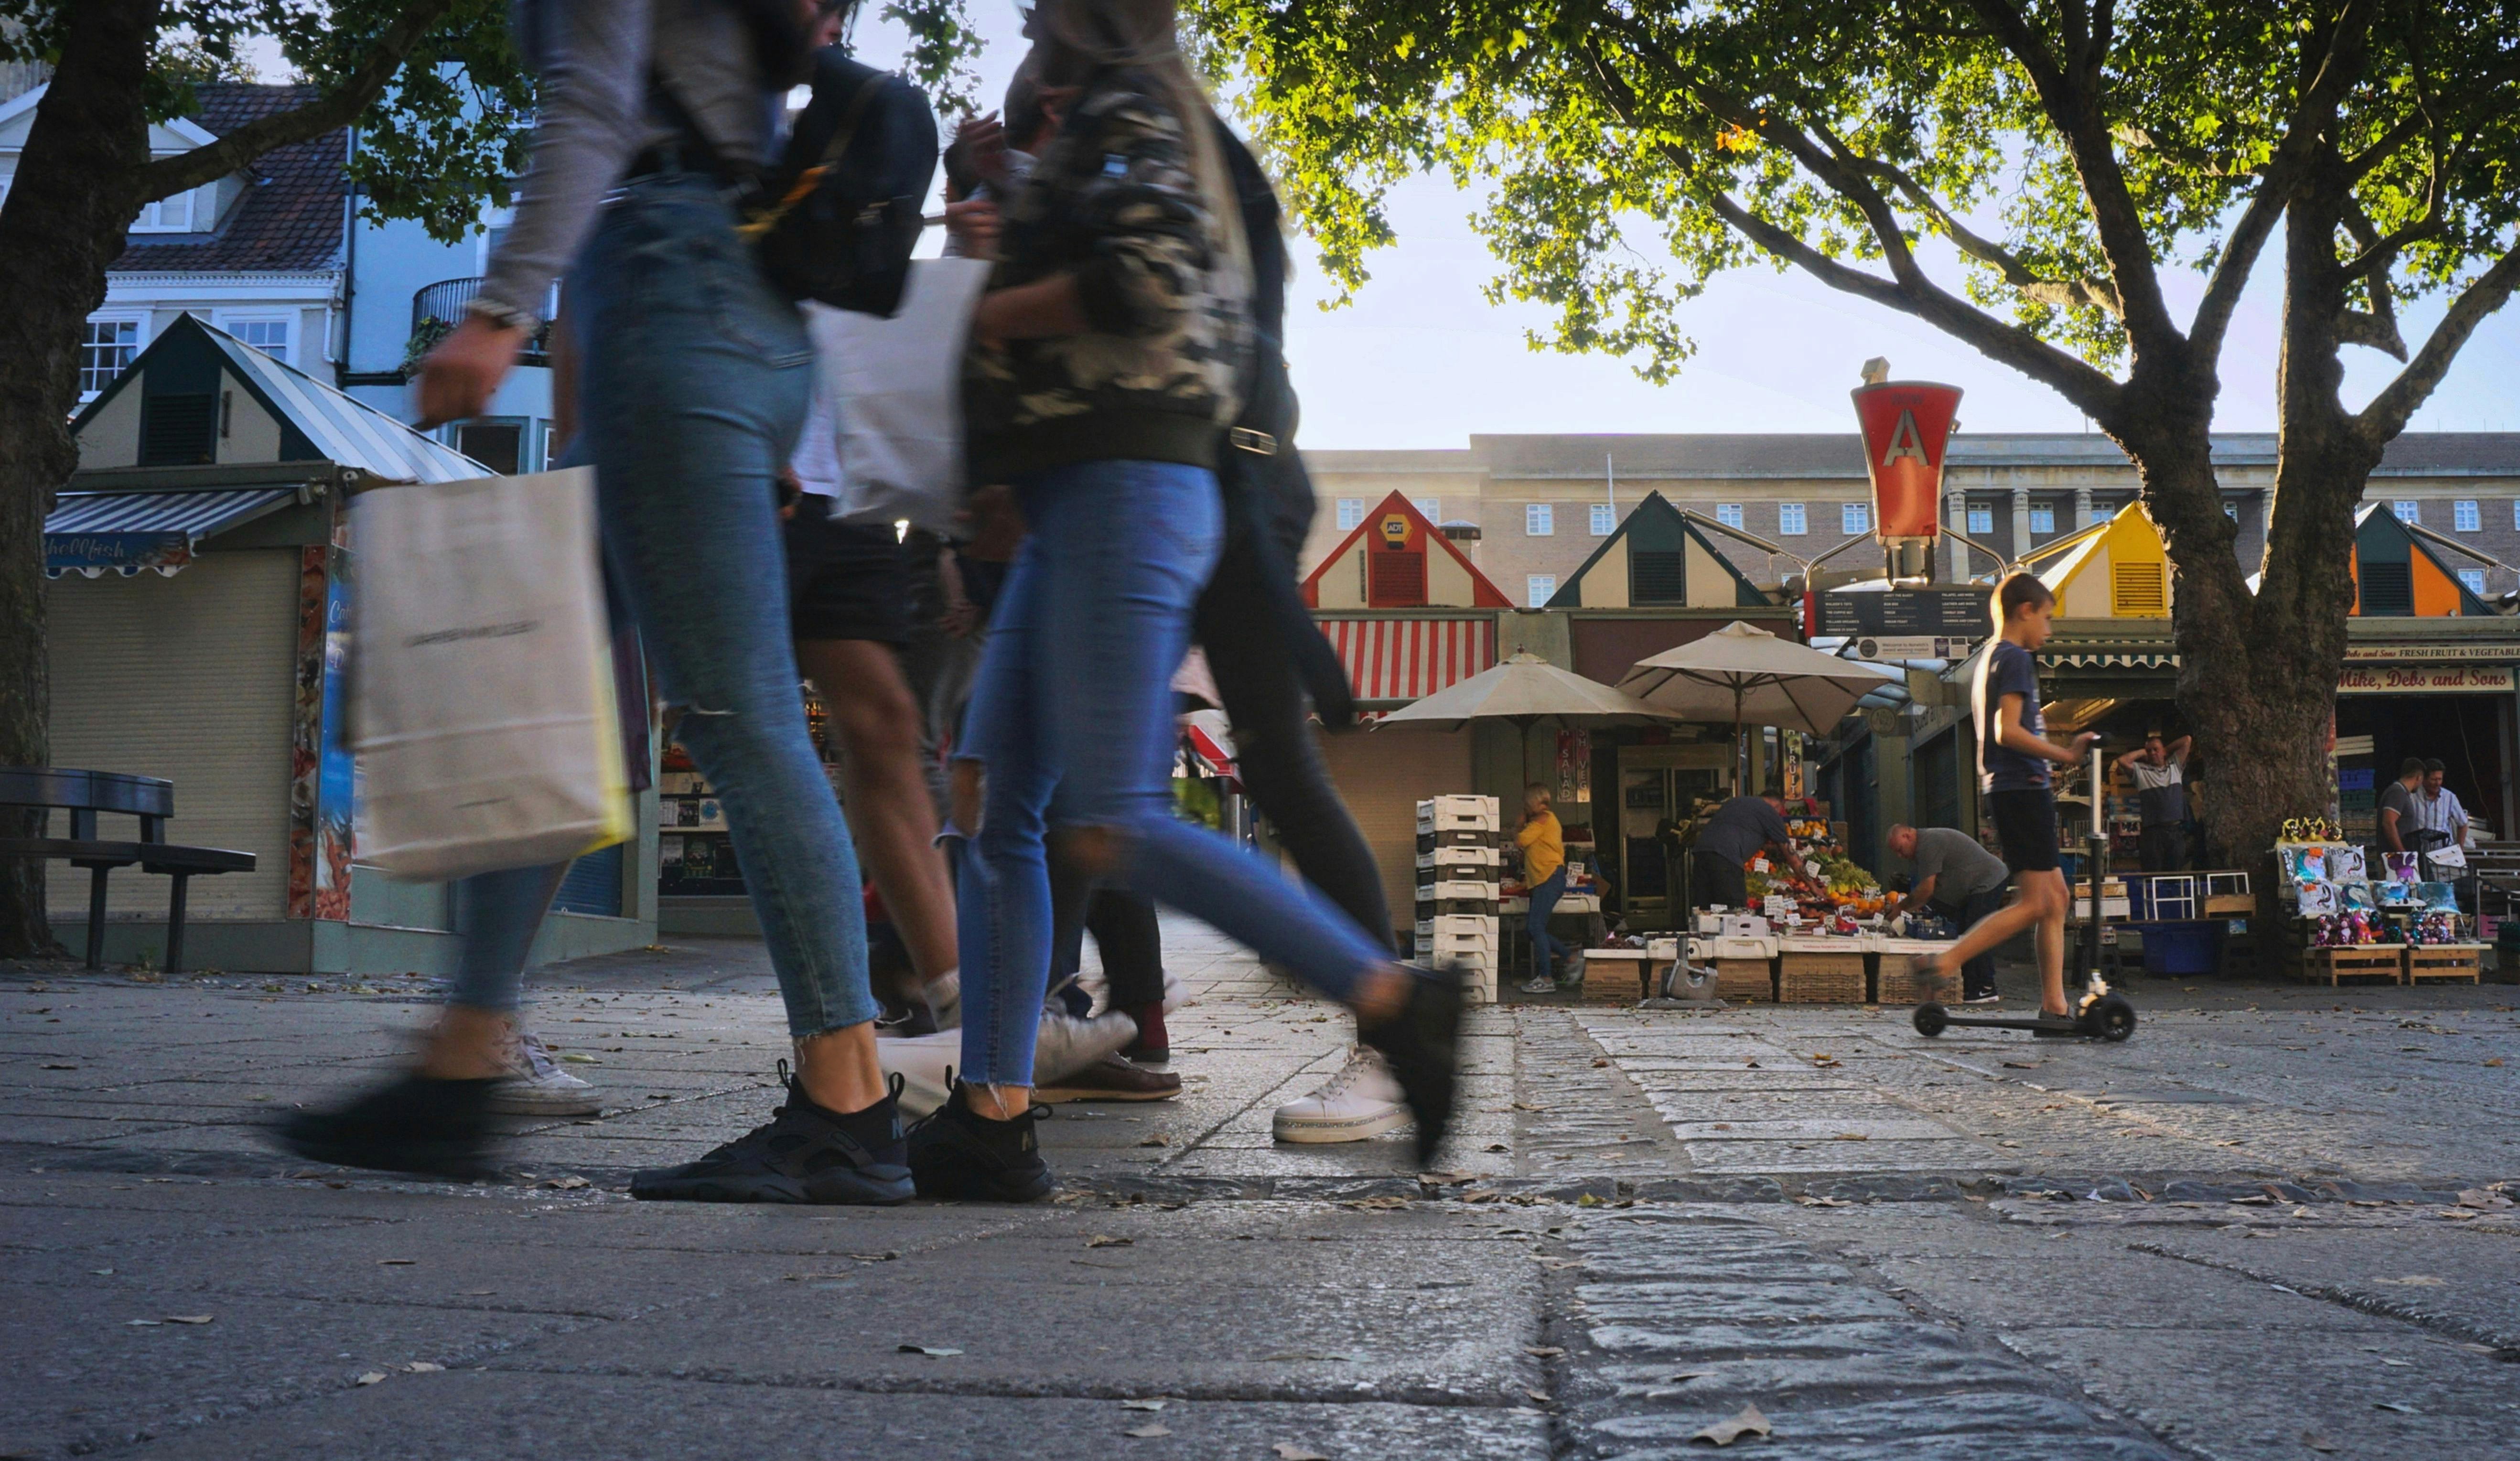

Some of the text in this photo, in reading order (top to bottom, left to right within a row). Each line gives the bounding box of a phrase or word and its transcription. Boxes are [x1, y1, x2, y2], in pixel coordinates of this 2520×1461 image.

[1883, 409, 1930, 466] A
[1387, 524, 1403, 532] ADT
[2379, 649, 2396, 657] Sons
[2339, 669, 2507, 690] Mike, Debs and Sons
[1562, 748, 1571, 798] SALAD
[1579, 760, 1587, 790] VEG
[1788, 746, 1797, 794] FRUIT
